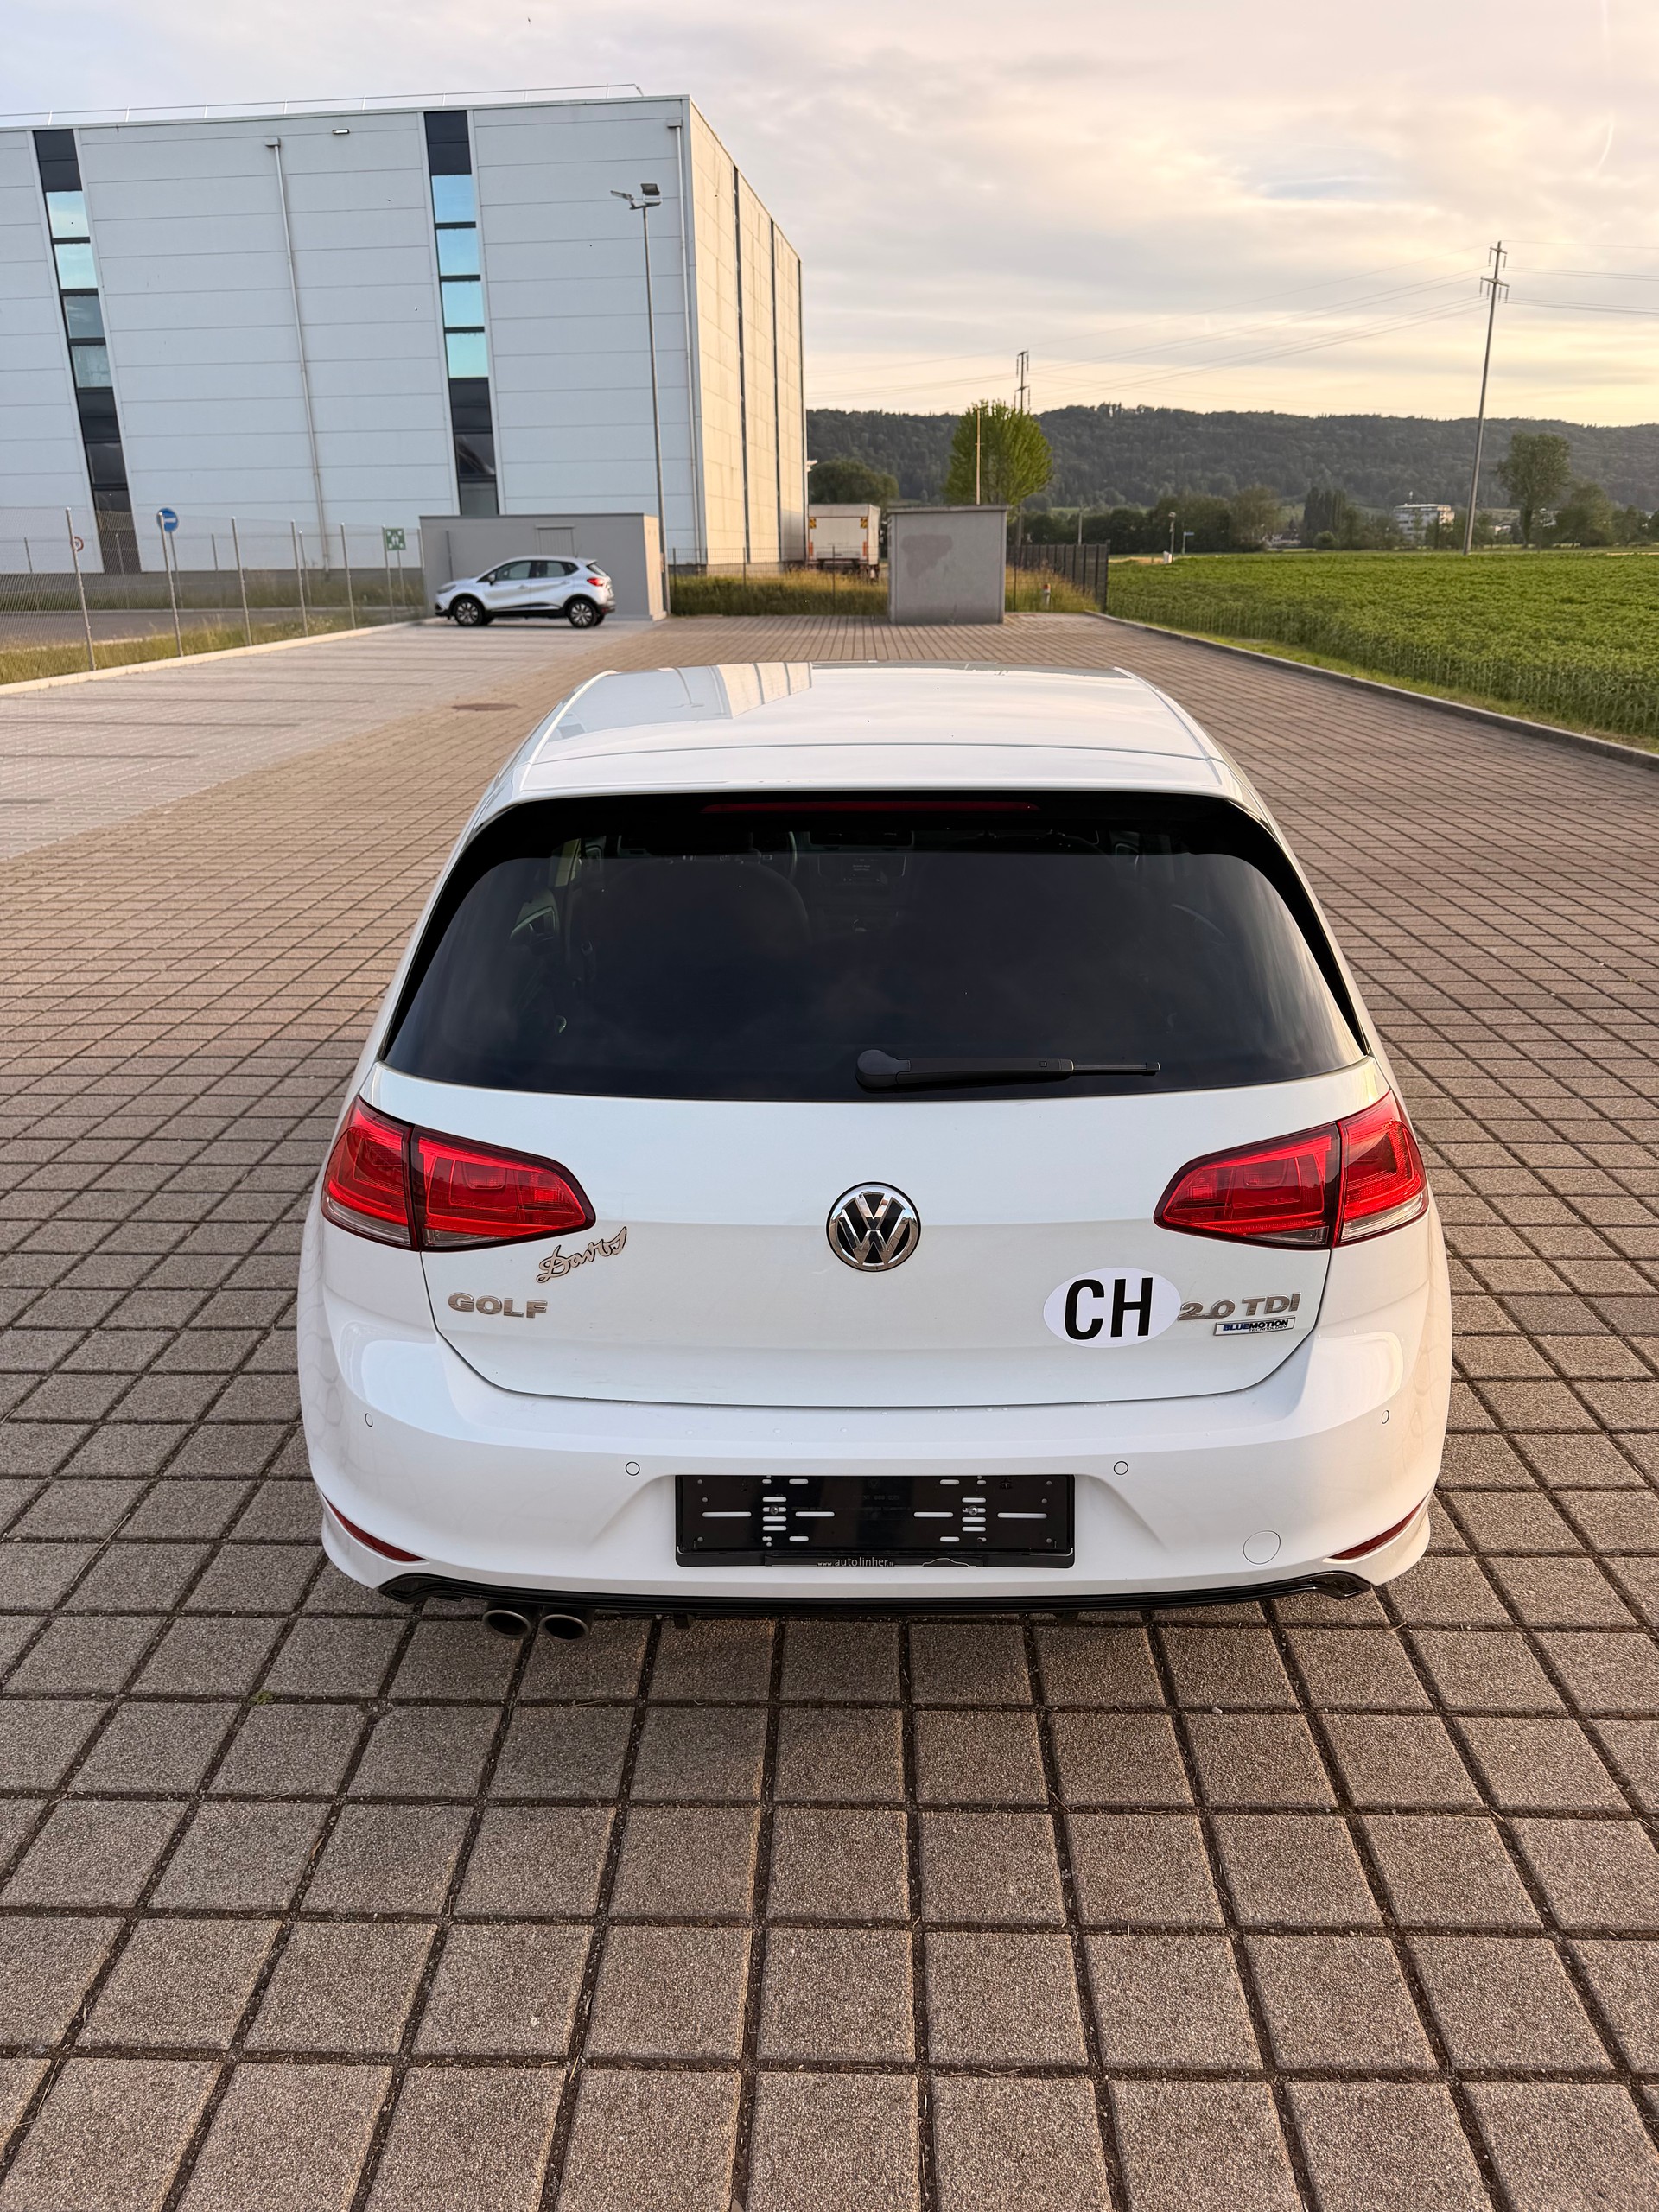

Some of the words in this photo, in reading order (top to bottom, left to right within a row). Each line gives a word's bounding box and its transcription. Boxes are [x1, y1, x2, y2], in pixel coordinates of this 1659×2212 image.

[834, 1191, 912, 1266] VW
[448, 1292, 548, 1319] GOLF
[1065, 1277, 1153, 1340] CH
[1177, 1300, 1236, 1321] 2.0
[1242, 1292, 1301, 1316] TDI
[1223, 1319, 1288, 1331] BLUEMOTION
